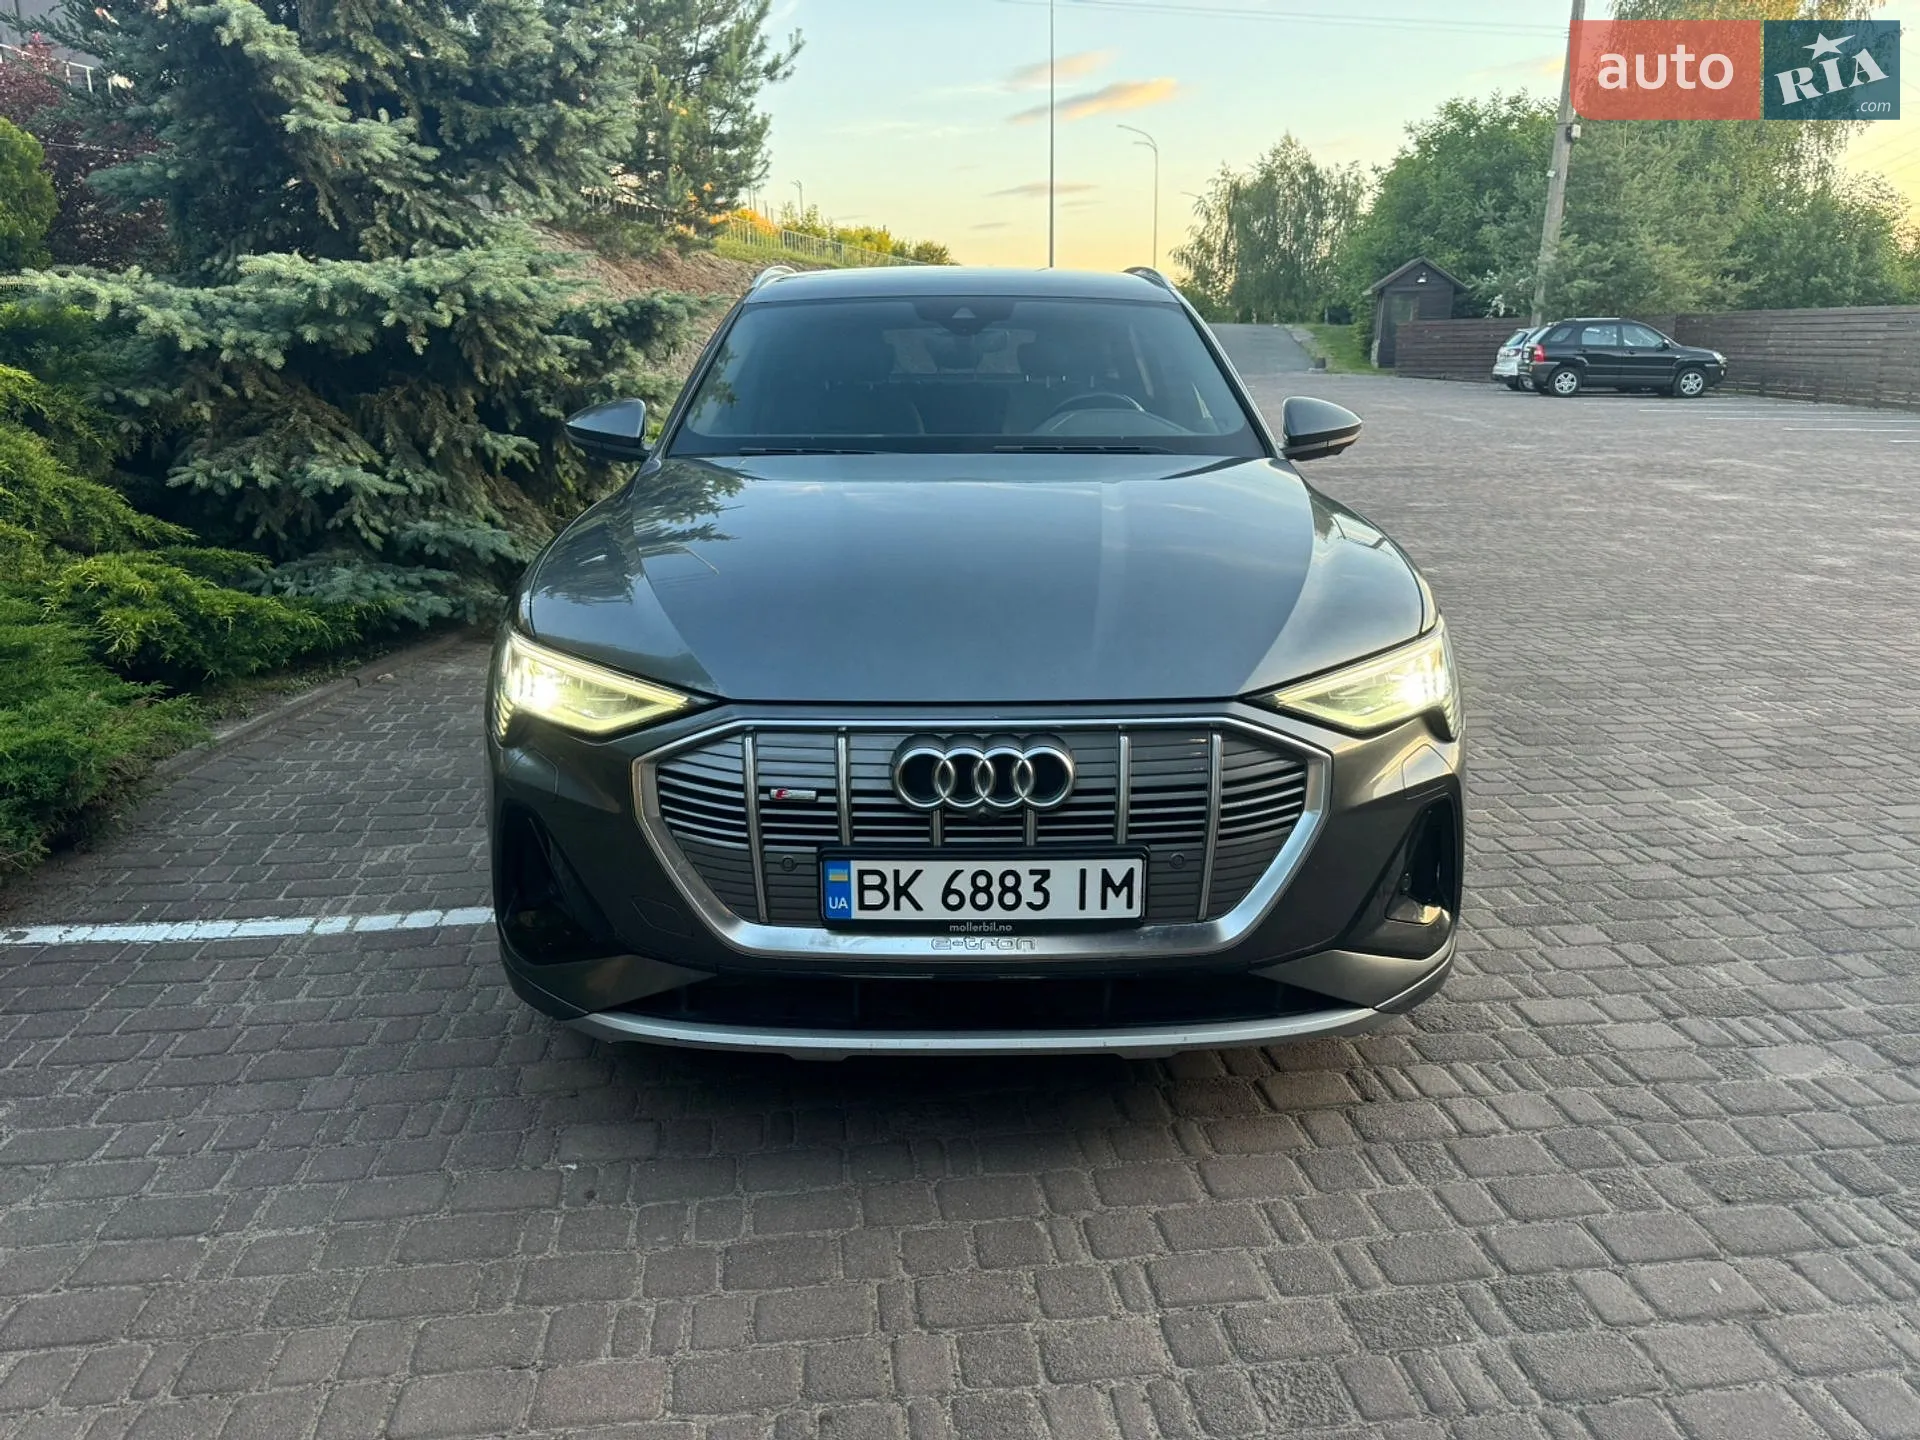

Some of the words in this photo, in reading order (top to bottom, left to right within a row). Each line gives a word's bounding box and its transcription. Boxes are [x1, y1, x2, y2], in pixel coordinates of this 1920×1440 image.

[857, 868, 924, 911] BK
[941, 868, 1051, 912] 6883
[1078, 867, 1135, 911] IM
[829, 897, 848, 909] UA
[949, 922, 1013, 933] mollerbil.no
[931, 936, 1036, 950] e-tron
